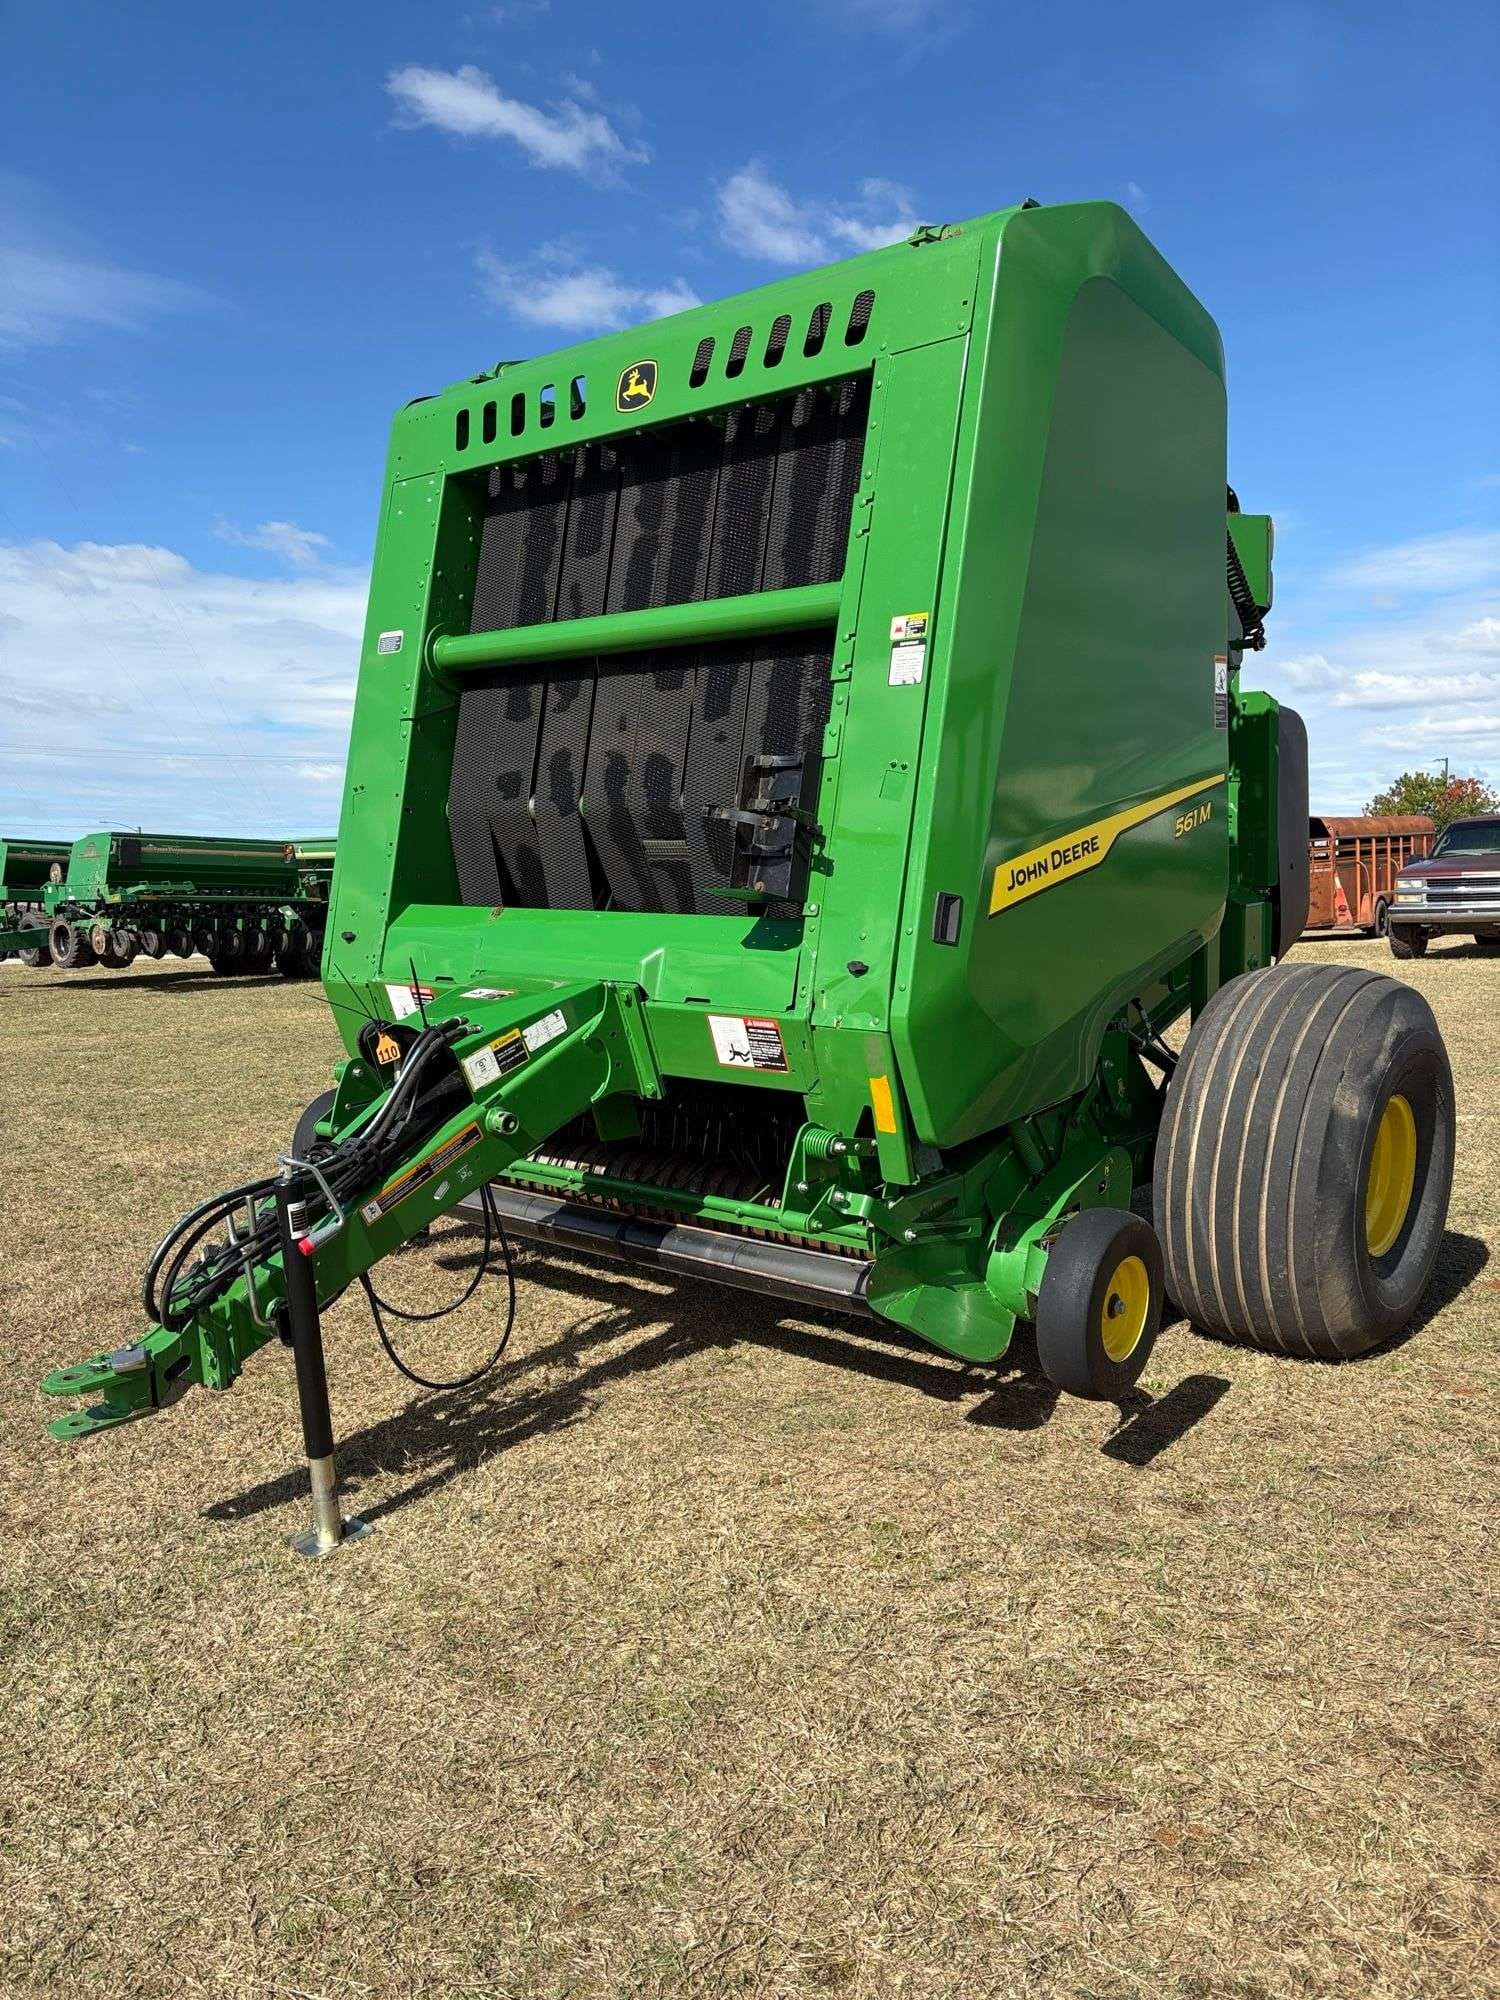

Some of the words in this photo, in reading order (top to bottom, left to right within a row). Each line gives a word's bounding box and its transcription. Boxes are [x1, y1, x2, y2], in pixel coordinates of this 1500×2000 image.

[1007, 858, 1049, 891] JOHN
[1050, 835, 1100, 870] DEERE
[379, 1046, 398, 1063] 110
